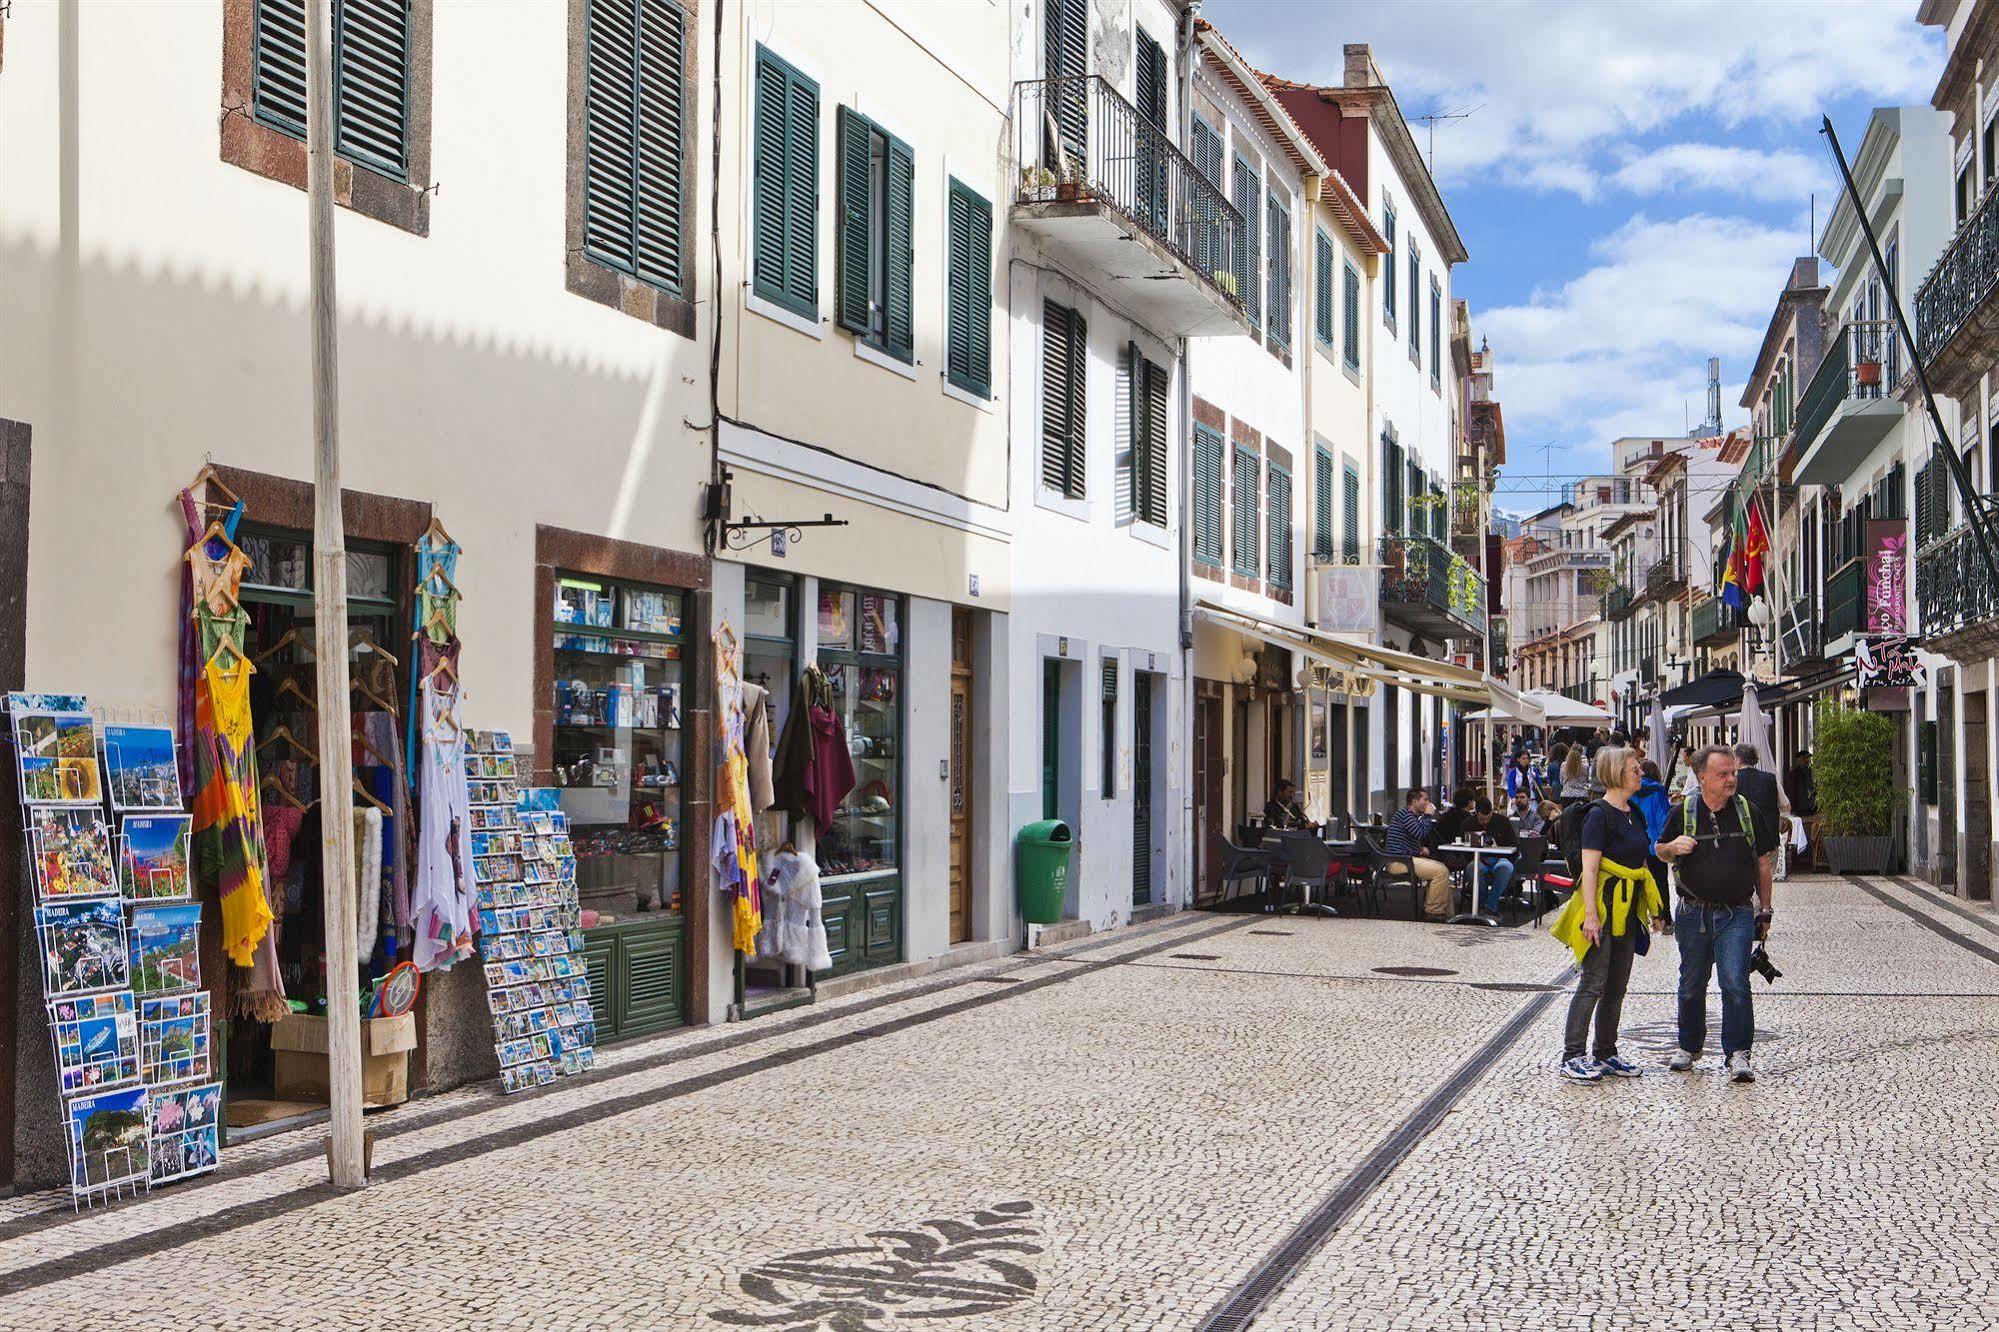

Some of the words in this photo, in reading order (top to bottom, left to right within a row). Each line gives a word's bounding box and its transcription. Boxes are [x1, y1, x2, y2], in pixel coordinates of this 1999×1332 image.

[1878, 550, 1893, 608] Funchal
[1869, 637, 1907, 662] Tá
[132, 820, 152, 829] MADEIRA
[46, 908, 69, 917] MADEIRA
[72, 1100, 95, 1111] MADEIRA
